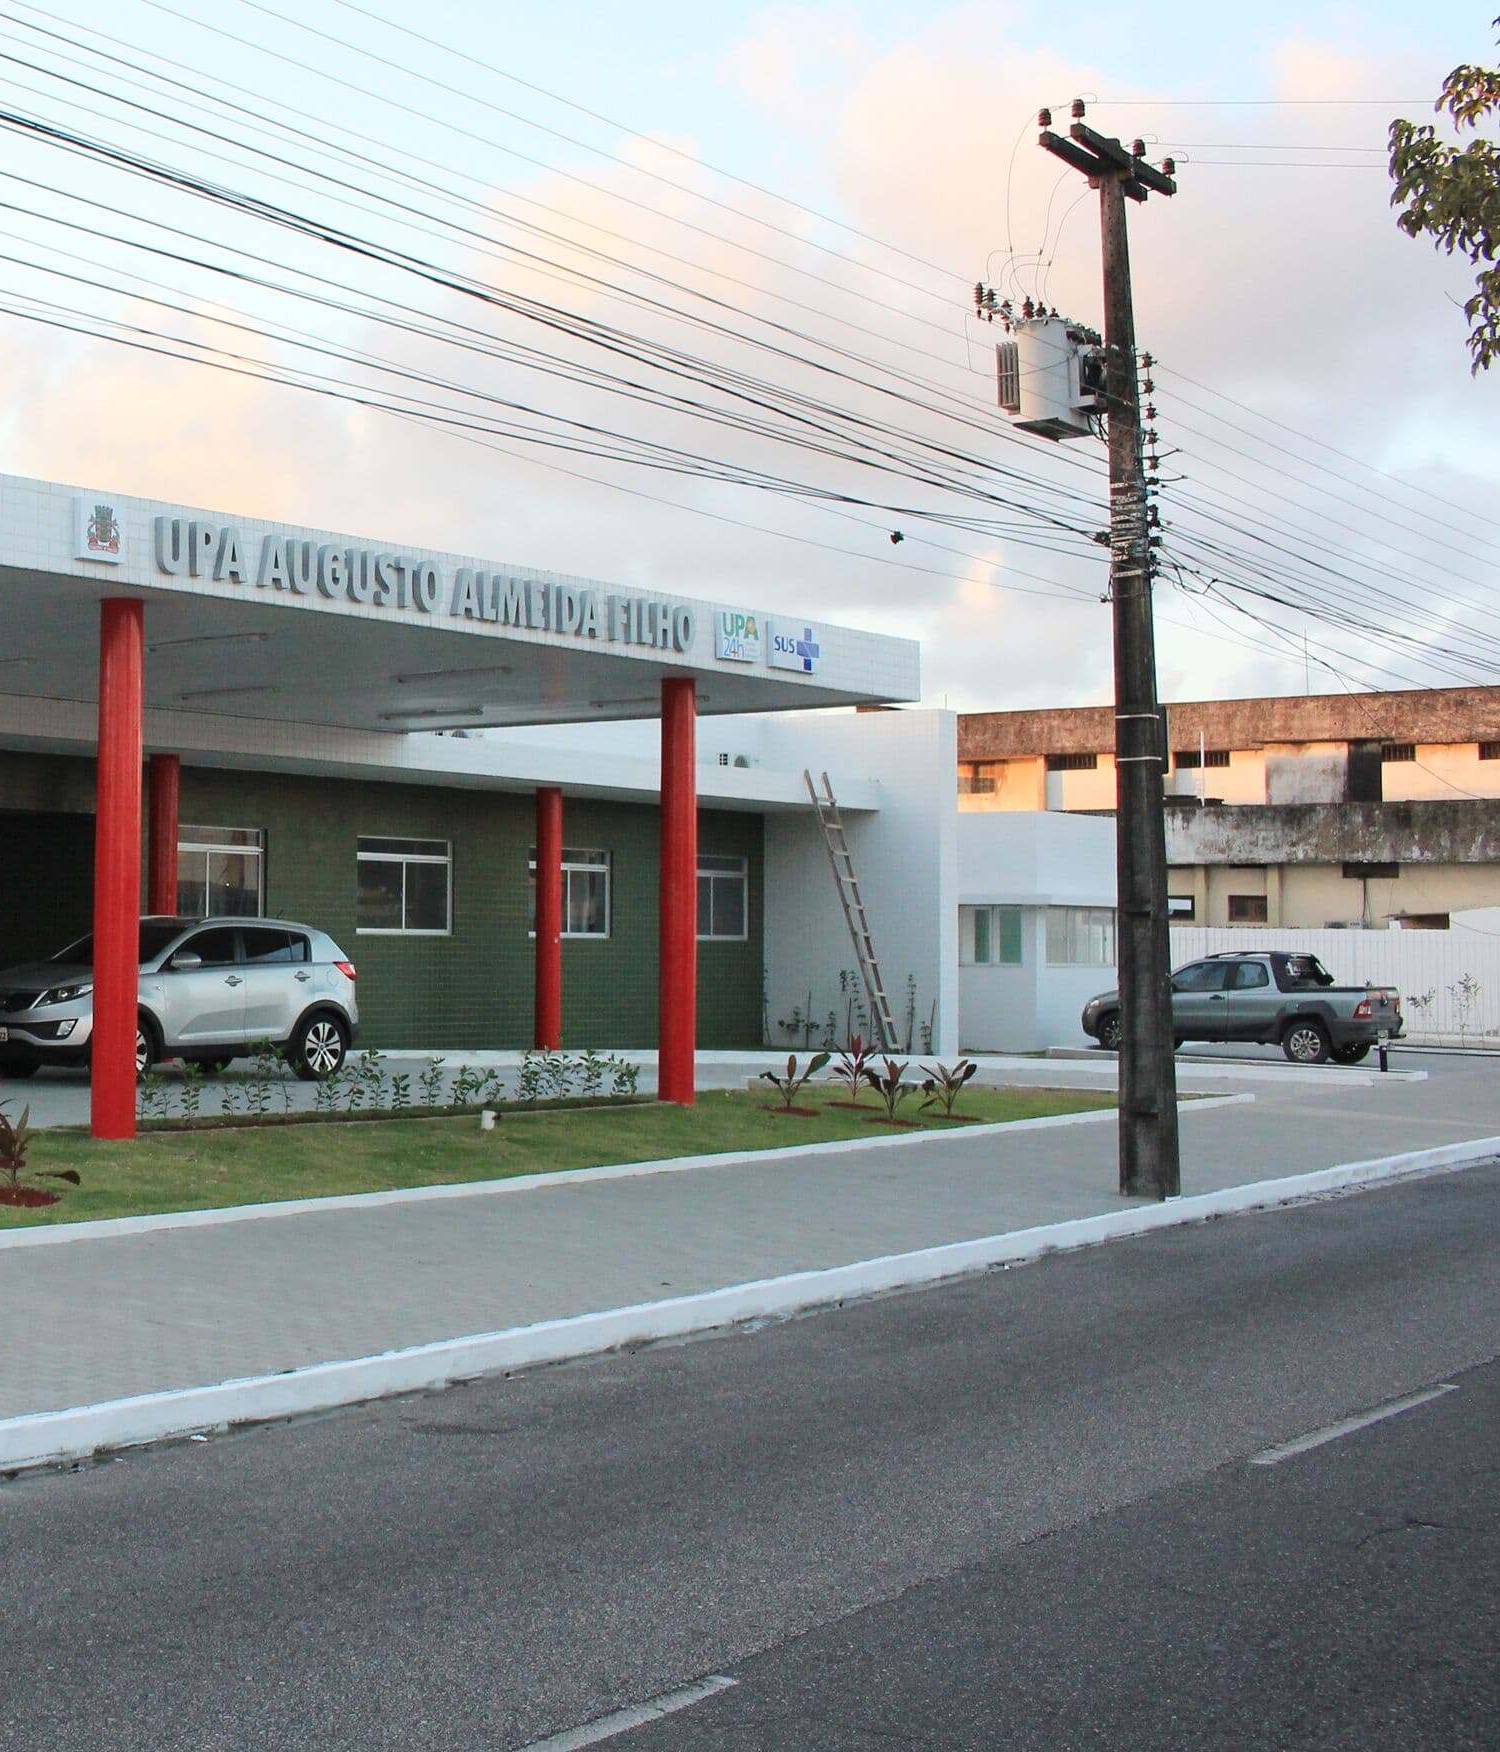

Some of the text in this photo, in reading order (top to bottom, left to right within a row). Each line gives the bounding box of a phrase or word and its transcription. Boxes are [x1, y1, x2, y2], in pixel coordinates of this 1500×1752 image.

[155, 516, 697, 652] UPA AUGUSTO ALMEIDA FILHO
[723, 612, 759, 640] UPA
[724, 637, 745, 658] 24h
[774, 636, 795, 653] SUS
